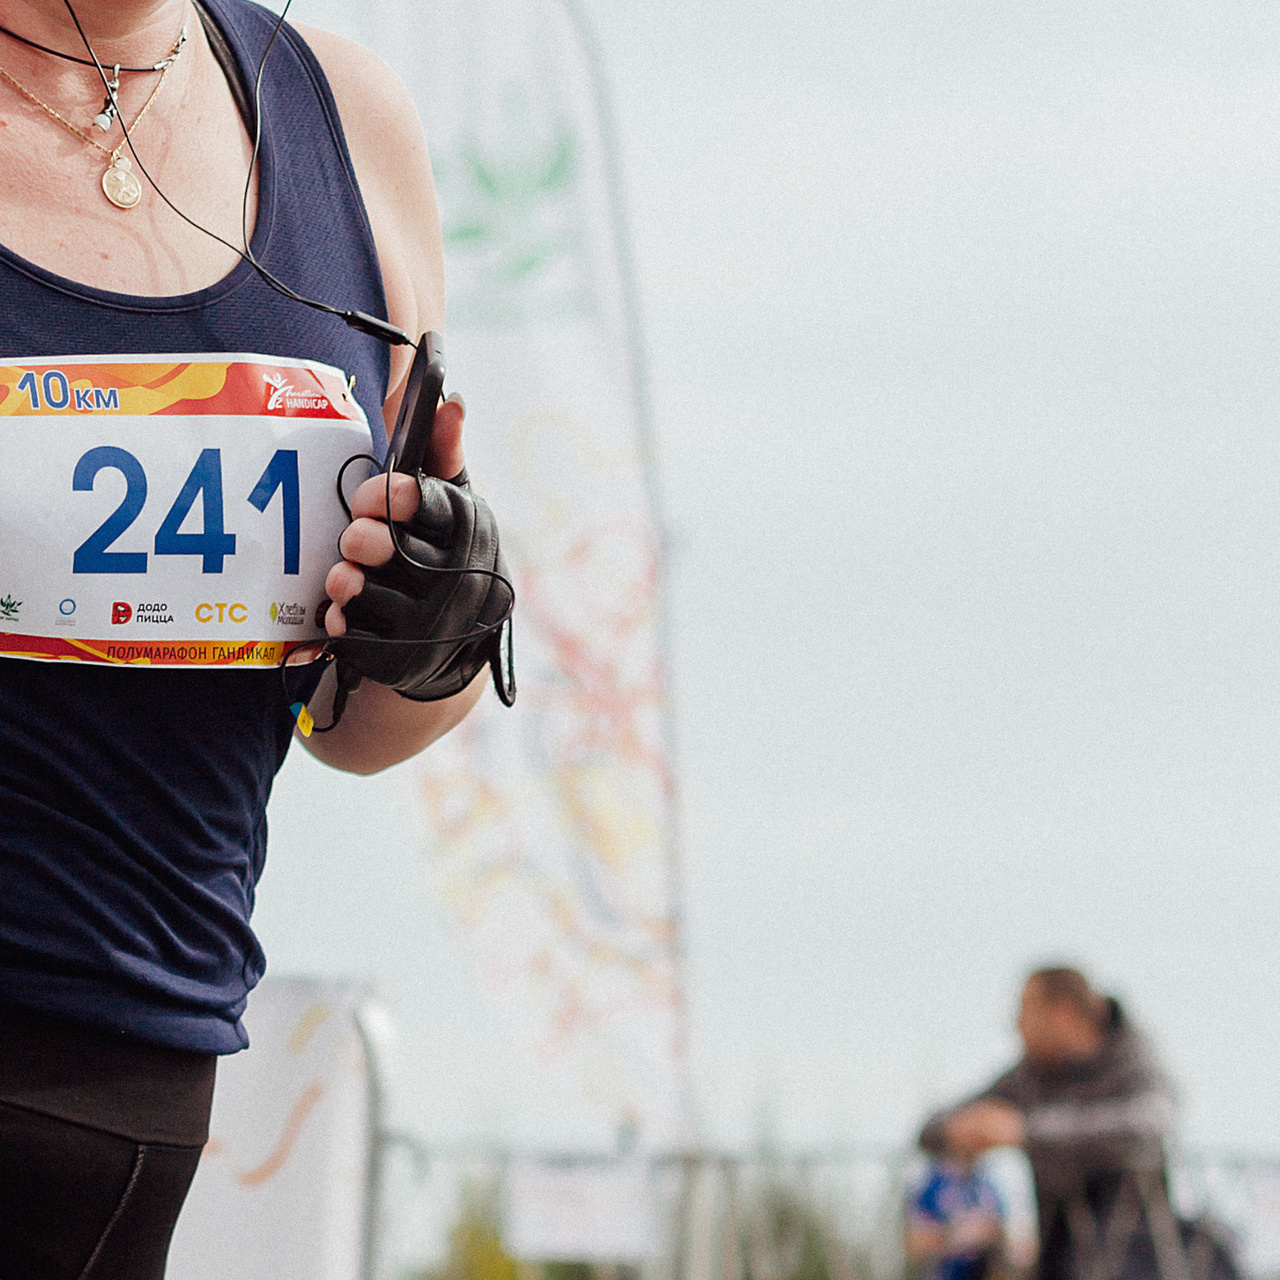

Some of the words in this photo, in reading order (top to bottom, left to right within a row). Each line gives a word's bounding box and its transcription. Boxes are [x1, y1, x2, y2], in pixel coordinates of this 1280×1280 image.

[17, 370, 70, 410] 10
[286, 398, 329, 410] HANDICAP
[72, 445, 301, 575] 241
[136, 603, 168, 613] ДОДО
[136, 614, 175, 624] ПИЦЦА
[107, 646, 207, 660] ПОЛУМАРАФОН
[213, 646, 276, 661] ГАНДИКАП
